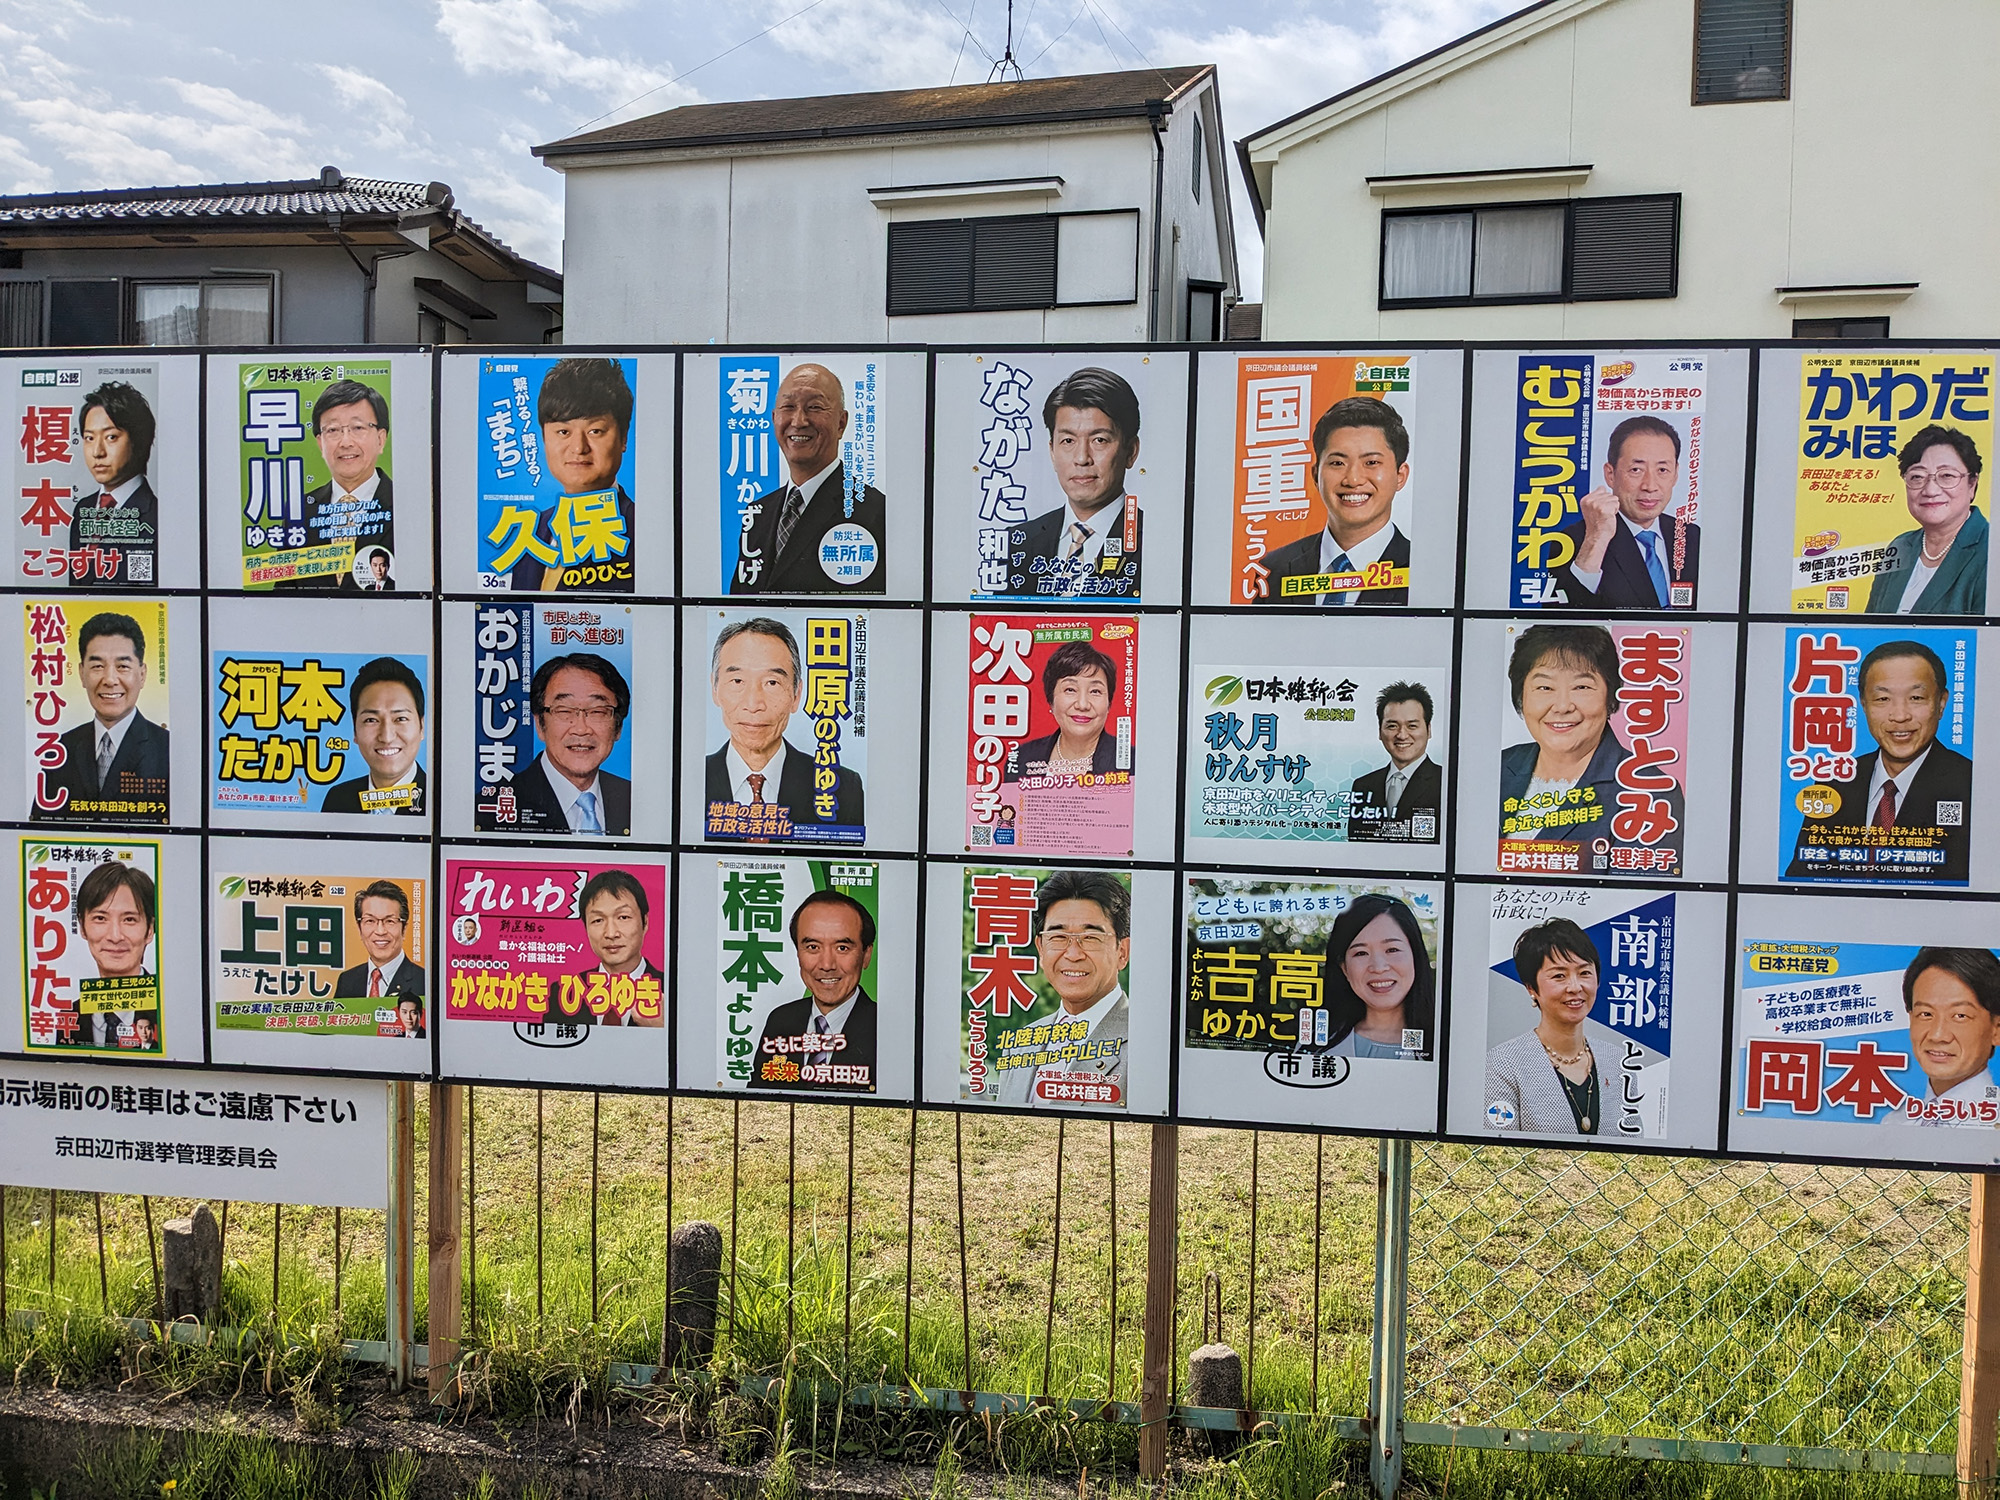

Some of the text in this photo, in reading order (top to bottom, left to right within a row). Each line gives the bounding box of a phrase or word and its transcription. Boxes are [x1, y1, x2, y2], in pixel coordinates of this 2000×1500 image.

[267, 366, 334, 383] 日本維新の会
[1245, 364, 1318, 372] 京田辺市議会議員候補
[1370, 367, 1410, 379] 自民党
[1669, 362, 1703, 371] 公明党
[24, 373, 79, 384] 自民党 公認
[1372, 383, 1392, 391] 公認
[1597, 388, 1702, 398] 物価高から市民の
[1806, 367, 1990, 421] かわだ
[1597, 400, 1691, 410] 生活を守ります!
[727, 418, 770, 429] きくかわ
[866, 364, 875, 488] 安全安心 笑顔のコミュニティ
[486, 398, 522, 480] 「まち」
[1581, 404, 1589, 470] 京田辺市議会議員候補
[1803, 425, 1897, 459] みほ
[243, 389, 305, 524] 早川
[1517, 365, 1581, 569] むこうがわ
[21, 405, 73, 537] 榎本
[843, 442, 854, 518] 京田辺を創ります
[978, 361, 1033, 592] ながた 和也
[1687, 417, 1701, 523] あなたのむこうがわに
[1801, 469, 1880, 479] 京田辺を変える!
[1241, 375, 1312, 599] 国重 こうへい
[1809, 481, 1849, 492] あなたと
[318, 500, 382, 515] 地方行政のプロが、
[1826, 493, 1895, 504] かわだみほで!
[79, 507, 139, 517] まちづくりから
[310, 512, 392, 527] 市民の目線・市民の声を
[1275, 511, 1309, 521] くにしげ
[79, 520, 154, 537] 都市経営へ
[247, 527, 306, 547] ゆきお
[319, 525, 384, 539] 市政に実践します!
[488, 492, 627, 573] 久保
[833, 531, 863, 541] 防災士
[22, 547, 122, 579] こうすけ
[822, 545, 874, 563] 無所属
[1011, 531, 1026, 588] かずや
[1800, 547, 1898, 573] 物価高から市民の
[251, 564, 296, 582] 維新改革
[563, 562, 632, 586] のりひこ
[837, 566, 862, 576] 2期目
[1029, 556, 1138, 574] あなたの声を
[1811, 558, 1901, 583] 生活を守ります!
[483, 575, 506, 588] 36歳
[1037, 577, 1133, 594] 市政に活かす
[1285, 576, 1330, 593] 自民党
[1520, 578, 1568, 604] 弘
[1797, 602, 1823, 610] 公明党
[543, 612, 600, 624] 市民と共に
[551, 628, 624, 644] 前へ進む!
[1036, 631, 1090, 641] 無所属市民派
[522, 610, 530, 692] 京田辺市議会議員候補
[804, 618, 852, 720] 田原
[853, 617, 867, 738] 京田辺市議会議員候補
[1124, 640, 1134, 714] いまこそ市民の力を!
[972, 622, 1033, 738] 次田
[1246, 676, 1359, 705] 日本維新の会
[219, 657, 345, 731] 河本
[477, 608, 519, 782] おかじま
[1789, 633, 1861, 753] 片岡
[1952, 640, 1966, 745] 京田辺市議会議員候補
[30, 604, 68, 811] 松村ひろし
[1304, 708, 1355, 721] 公認候補
[1204, 712, 1279, 750] 秋月
[1611, 631, 1683, 845] ますとみ
[219, 734, 345, 785] たかし
[1007, 741, 1019, 774] つぎた
[1205, 753, 1311, 784] けんすけ
[1787, 756, 1858, 781] つとむ
[1018, 777, 1076, 789] 次田のり子
[1203, 788, 1373, 804] 京田辺市をクリエイティブに!
[1503, 787, 1596, 813] 命とくらし守る
[1803, 790, 1832, 799] 無所属!
[70, 801, 166, 813] 元気な京田辺を創ろう
[478, 796, 517, 823] 一晃
[708, 802, 789, 819] 地域の意見で
[1202, 803, 1397, 819] 未来型サイバーシティーにしたい!
[1802, 800, 1833, 815] 59歳
[708, 819, 793, 835] 市政を活性化
[1502, 806, 1604, 833] 身近な相談相手
[1503, 843, 1580, 852] 大軍拡・大増税ストップ
[1808, 835, 1941, 847] 住んで良かったと思える京田辺～
[51, 847, 114, 864] 日本維新の会
[723, 862, 786, 870] 京田辺市議会議員候補
[1501, 852, 1579, 870] 日本共産党
[1610, 848, 1677, 869] 理津子
[1799, 848, 1946, 863] 「安全・安心」「少子高齢化」
[838, 867, 866, 875] 無所属
[1806, 863, 1935, 873] をキーワードに、まちづくりに取り組みます。
[248, 877, 344, 900] 日本維新の会 公認
[459, 871, 566, 912] れいわ
[830, 878, 872, 886] 自民党推薦
[1197, 896, 1346, 916] こどもに誇れるまち
[1493, 889, 1591, 905] あなたの声を
[413, 882, 421, 961] 京田辺市議会議員候補
[1492, 905, 1547, 921] 市政に!
[28, 866, 73, 1011] ありた
[220, 900, 344, 969] 上田
[1199, 924, 1260, 940] 京田辺を
[499, 941, 583, 953] 豊かな福祉の街へ!
[1750, 943, 1838, 954] 大軍拡・大増税ストップ
[518, 953, 565, 963] 介護福祉士
[1759, 957, 1829, 973] 日本共産党
[722, 872, 784, 1081] 橋本 よしゆき
[1191, 948, 1203, 1001] よしたか
[1204, 947, 1326, 1006] 吉高
[1607, 915, 1659, 1028] 南部
[1658, 916, 1672, 1029] 京田辺市議会議員候補
[222, 968, 331, 997] うえだ たけし
[967, 874, 1038, 1094] 青木 こうじろう
[83, 990, 154, 1002] 子育て世代の目線で
[451, 970, 661, 1018] かながき ひろゆき
[1765, 984, 1862, 1005] 子どもの医療費を
[97, 1000, 143, 1011] 市政へ繋ぐ!
[221, 1002, 345, 1015] 確かな実績で京田辺を前へ
[1765, 997, 1877, 1020] 高校卒業まで無料に
[30, 1010, 80, 1038] 幸平
[266, 1014, 371, 1028] 決断、突破、実行力!!
[1202, 1008, 1296, 1040] ゆかこ
[1301, 1010, 1311, 1042] 市民派
[1316, 1011, 1326, 1043] 無所属
[1782, 1011, 1894, 1033] 学校給食の無償化を
[762, 1034, 848, 1053] ともに築こう
[995, 1021, 1088, 1049] 北陸新幹線
[995, 1039, 1121, 1071] 延伸計画は中止に!
[1037, 1071, 1120, 1082] 大軍拡・大増税ストップ
[1277, 1054, 1337, 1078] 市議
[1618, 1040, 1645, 1134] としこ
[1745, 1039, 1998, 1122] 岡本 りょういち
[1044, 1086, 1112, 1101] 日本共産党
[55, 1136, 278, 1169] 京田辺市選挙管理委員会
